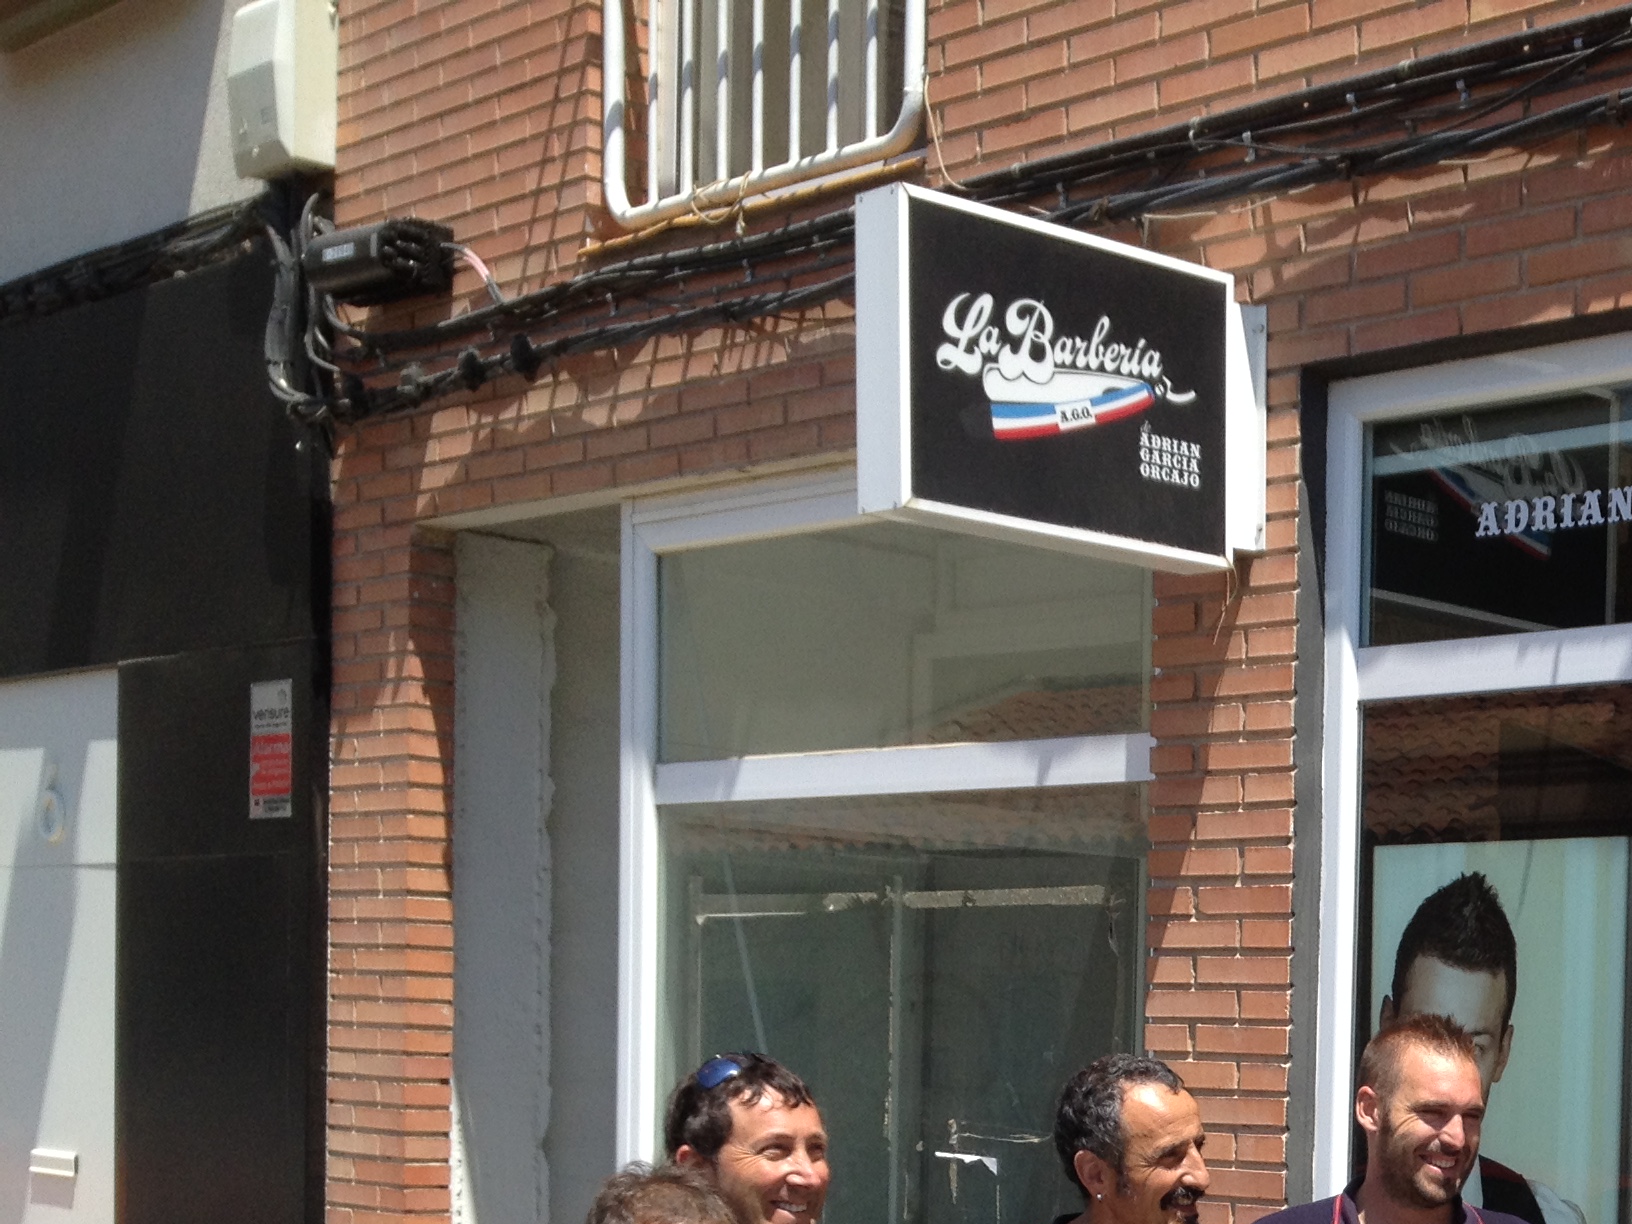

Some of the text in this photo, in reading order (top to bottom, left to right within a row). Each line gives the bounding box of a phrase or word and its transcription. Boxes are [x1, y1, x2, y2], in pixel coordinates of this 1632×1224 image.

[936, 292, 1001, 375] La
[1139, 432, 1201, 460] ADRIAN
[1139, 448, 1200, 473] GARCIA
[1139, 463, 1200, 488] ORCAJO
